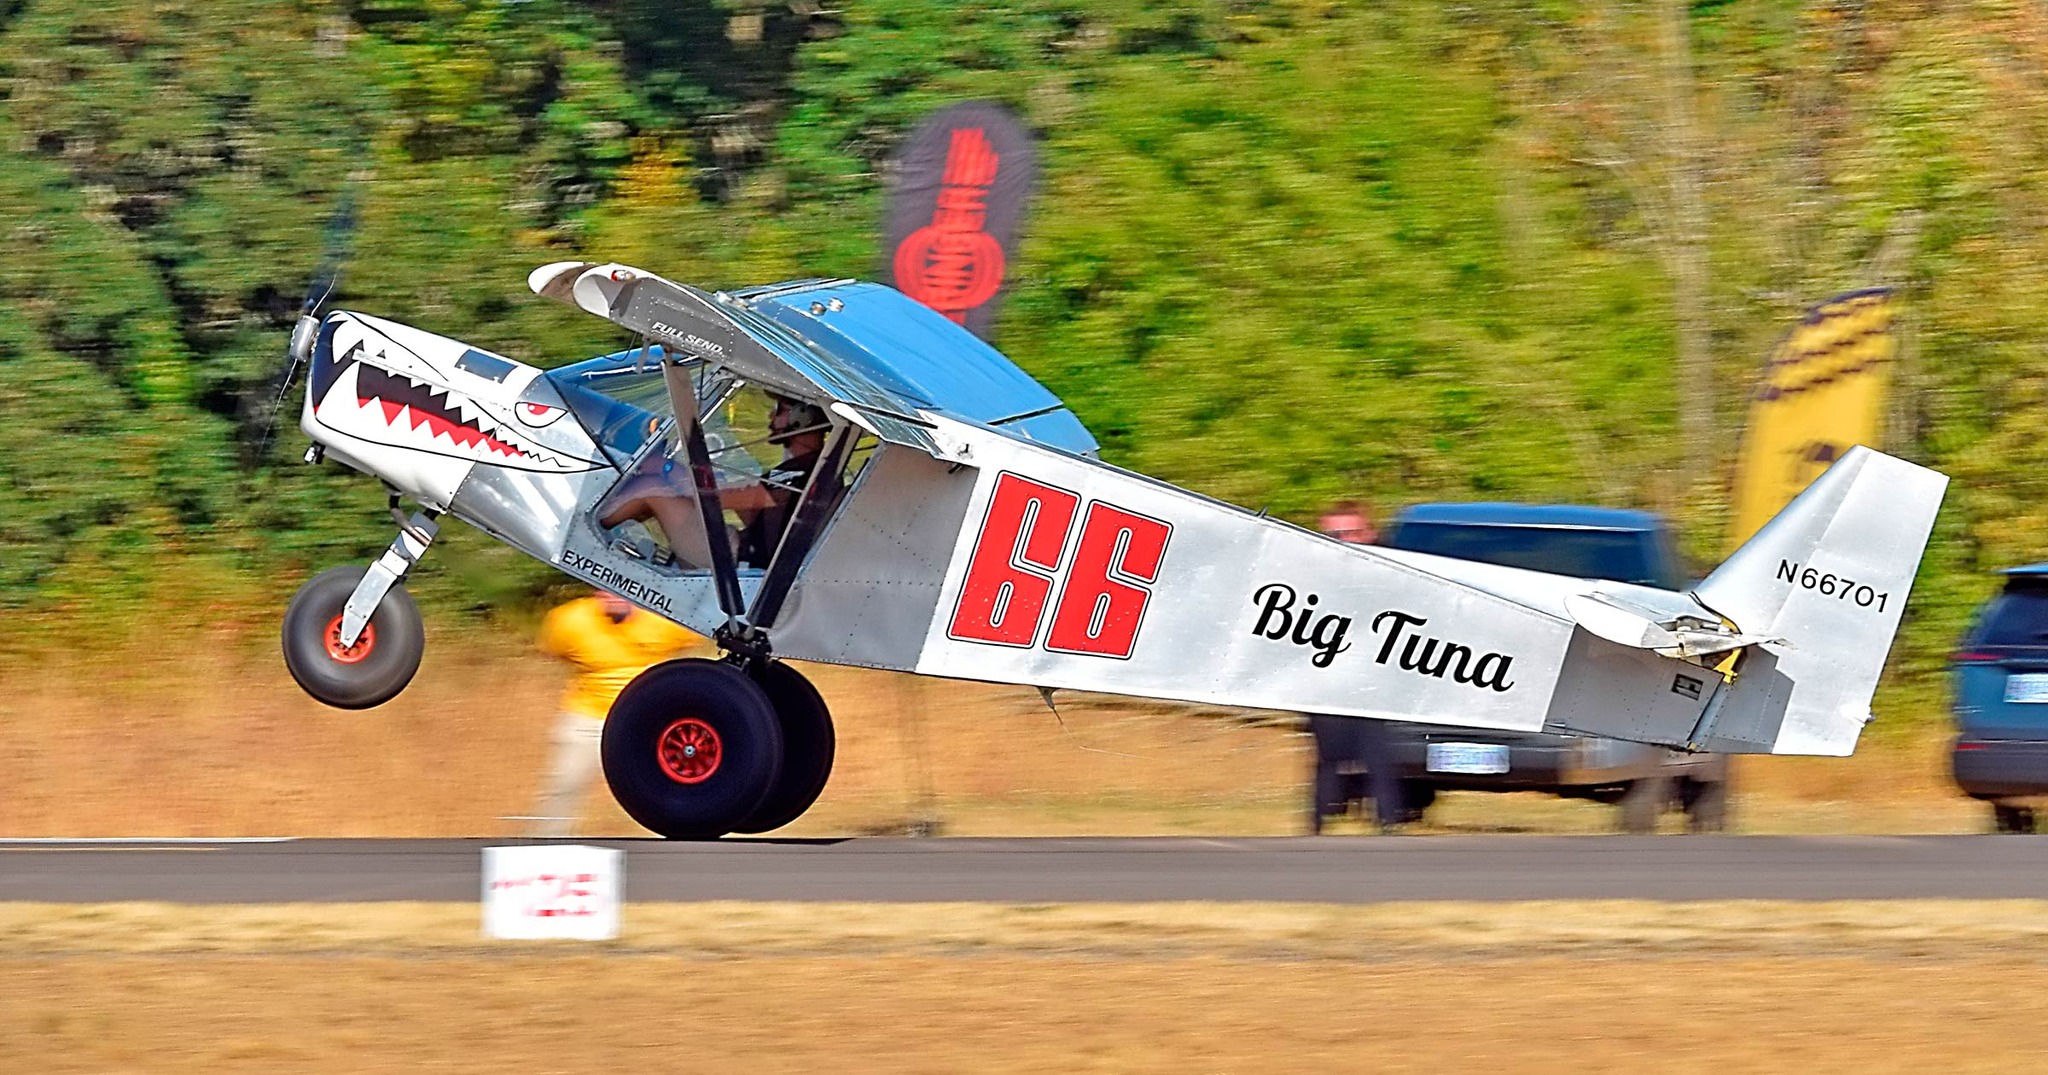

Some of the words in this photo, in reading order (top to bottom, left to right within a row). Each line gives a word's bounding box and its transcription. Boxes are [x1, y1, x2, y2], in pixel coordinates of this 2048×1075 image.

[652, 322, 684, 338] FULL
[562, 550, 673, 614] EXPERIMENTAL
[946, 470, 1174, 660] 66
[1776, 559, 1888, 613] N66701
[1252, 583, 1352, 668] Big
[1371, 611, 1515, 692] Tuna
